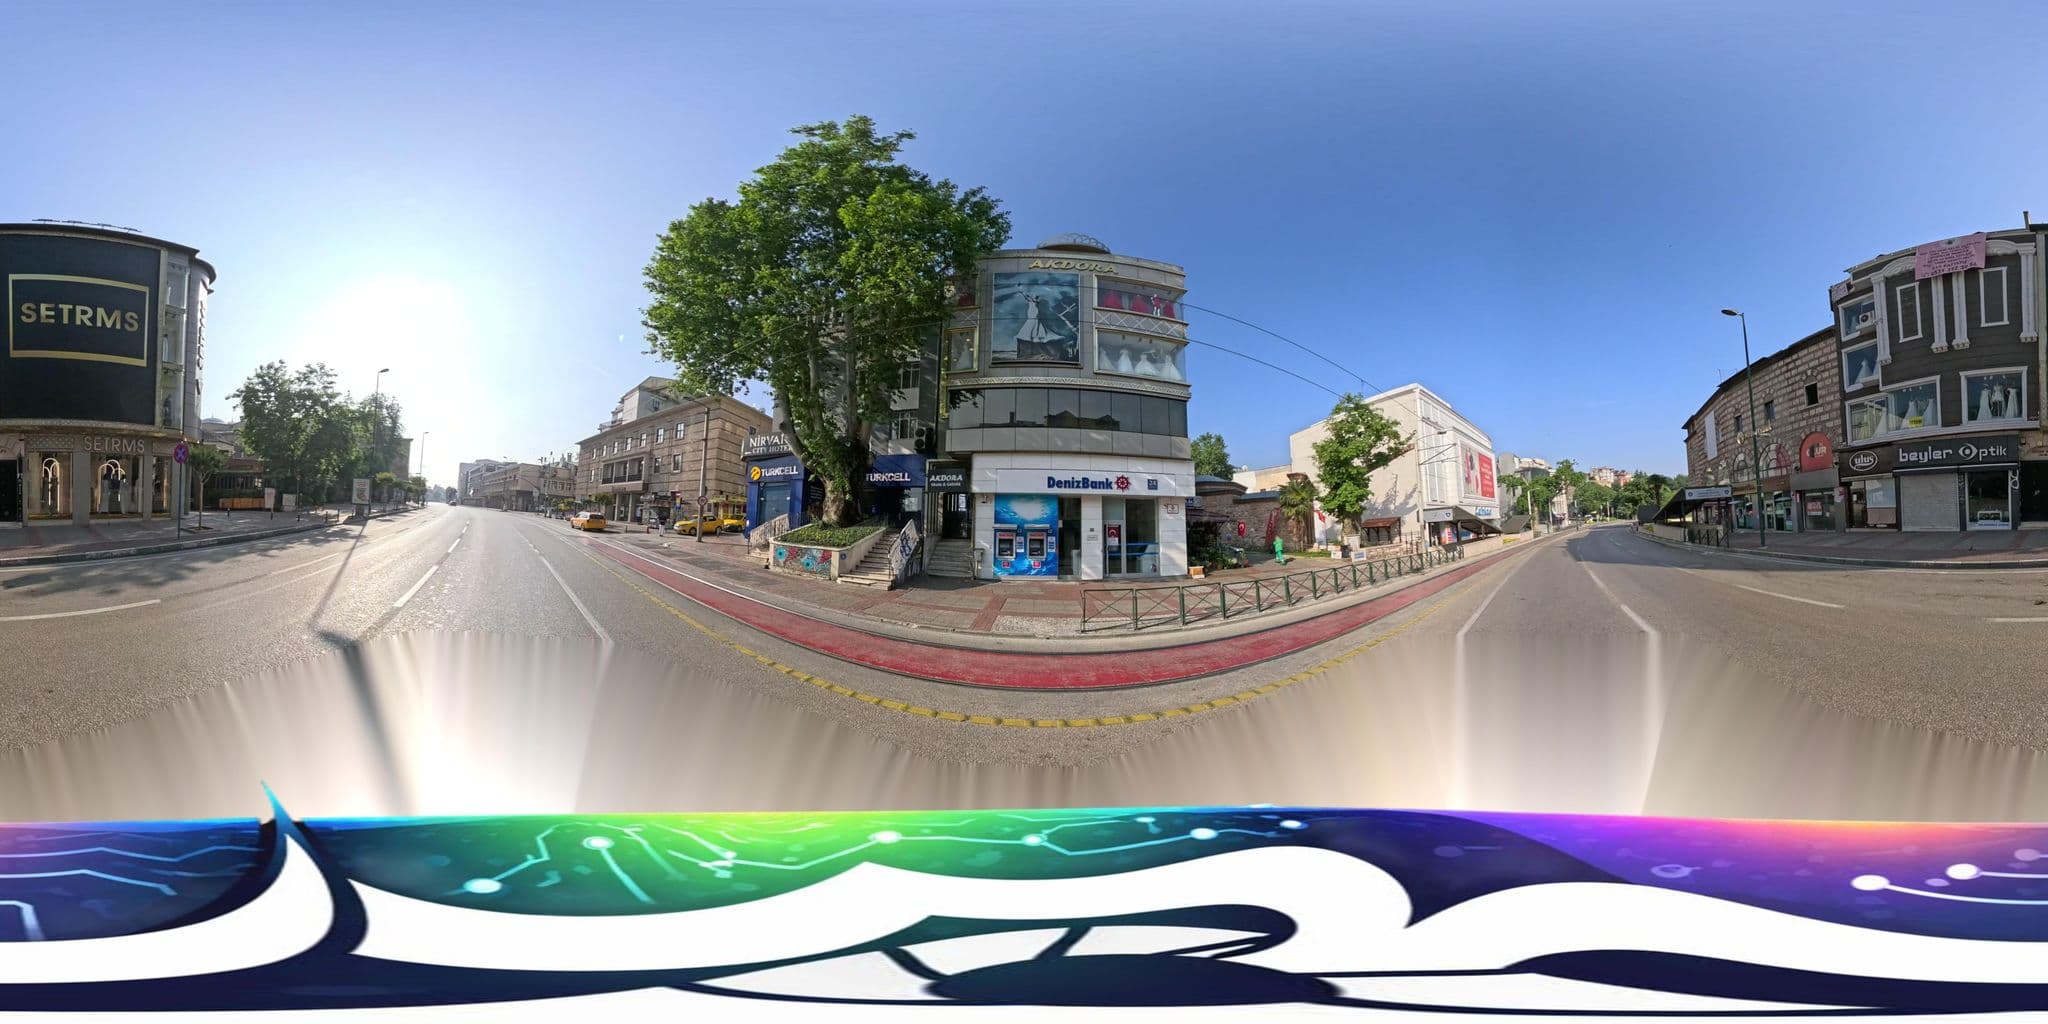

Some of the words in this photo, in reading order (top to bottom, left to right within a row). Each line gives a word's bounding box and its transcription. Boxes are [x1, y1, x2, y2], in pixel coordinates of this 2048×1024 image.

[1028, 259, 1119, 275] AKDORA
[20, 302, 139, 332] SETRMS
[83, 436, 145, 452] SETRMS
[1854, 455, 1874, 464] ulus
[1900, 447, 1952, 463] beyler
[761, 466, 798, 477] TURKCELL
[865, 472, 911, 481] TURKCELL
[1047, 476, 1113, 490] DenizBank
